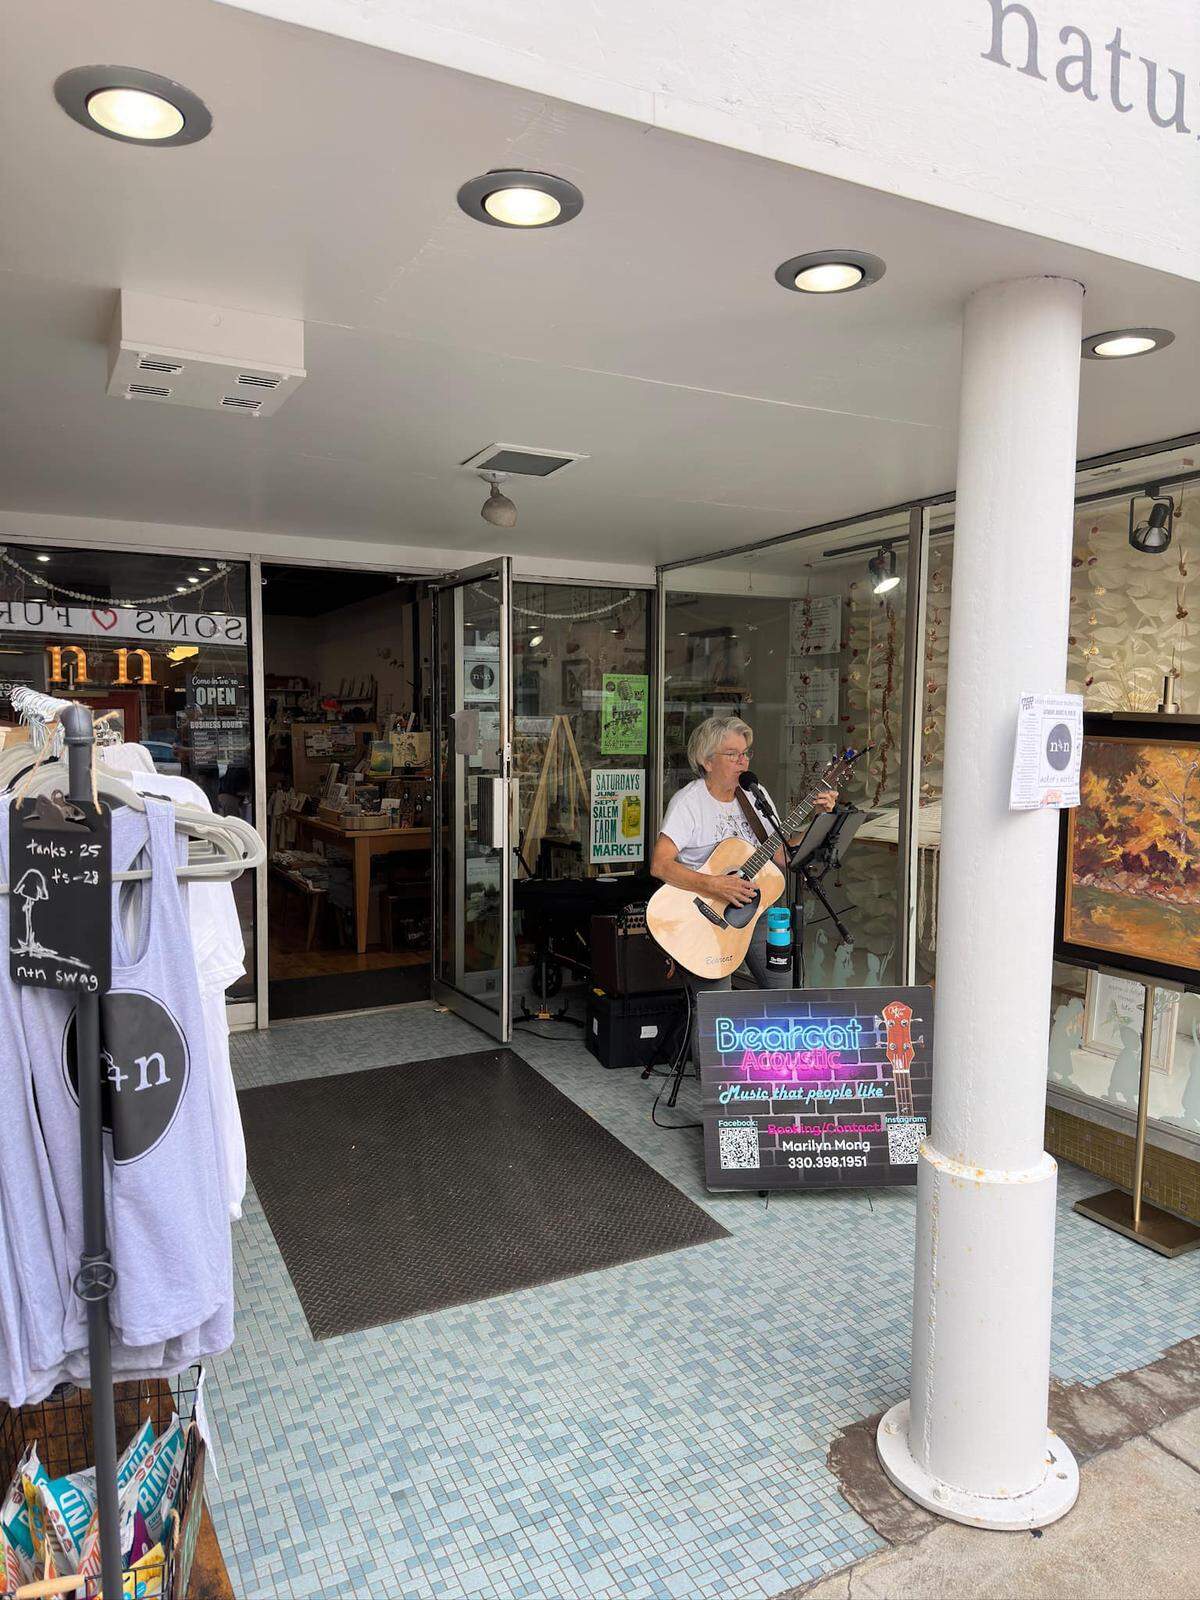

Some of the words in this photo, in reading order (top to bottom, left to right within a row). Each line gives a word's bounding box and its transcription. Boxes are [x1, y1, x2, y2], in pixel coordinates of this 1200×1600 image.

[980, 0, 1200, 139] natu
[196, 686, 236, 706] OPEN
[190, 720, 221, 729] BUSINESS
[596, 774, 640, 791] SATURDAYS
[593, 805, 619, 819] SALEM
[594, 819, 617, 844] FARM
[79, 843, 102, 858] 25
[592, 843, 642, 857] MARKET
[55, 968, 99, 992] swag
[715, 1017, 863, 1053] Bearcat
[741, 1048, 842, 1071] Acoustic
[773, 1084, 804, 1099] that
[807, 1084, 853, 1105] people
[718, 1119, 759, 1128] Facebook:
[782, 1139, 832, 1153] Marilyn
[834, 1139, 871, 1153] Mong
[788, 1155, 868, 1169] 330.398.1951
